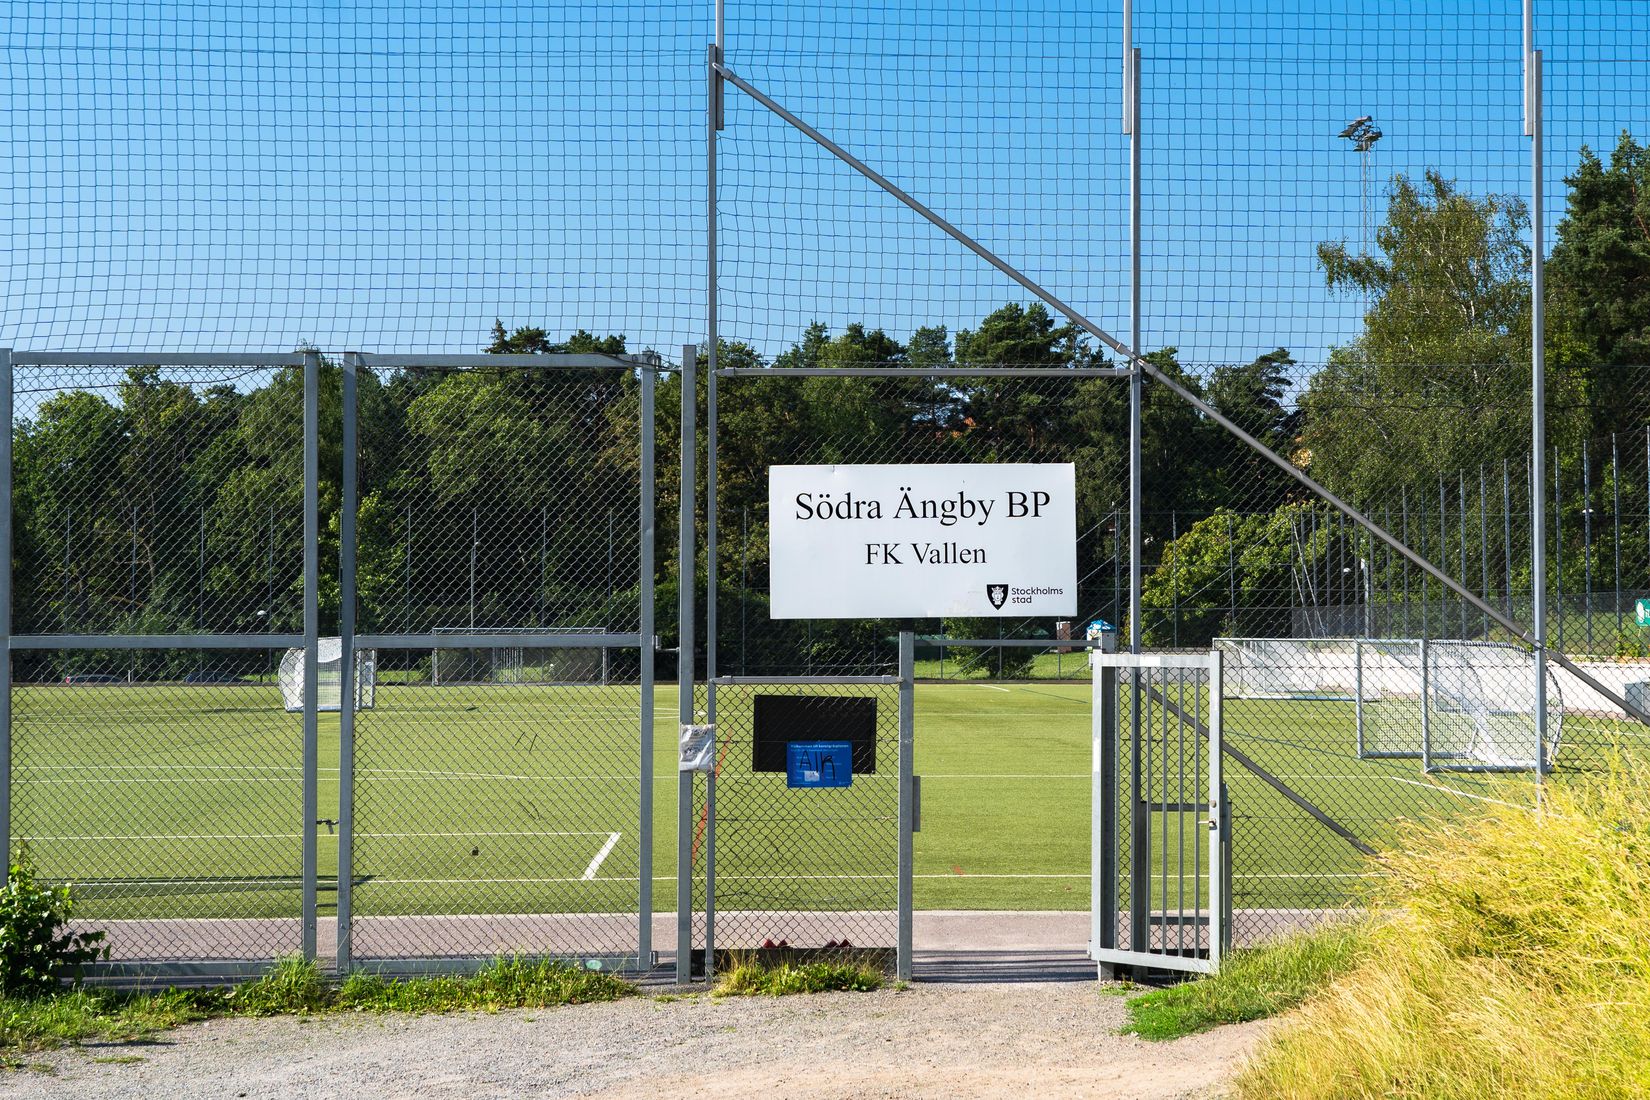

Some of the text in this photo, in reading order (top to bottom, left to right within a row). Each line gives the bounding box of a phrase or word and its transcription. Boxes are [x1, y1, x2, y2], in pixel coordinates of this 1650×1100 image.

[795, 486, 1051, 527] Södra Ängby BP
[865, 542, 987, 565] FK Vallen
[1011, 586, 1064, 596] Stockholms
[1011, 596, 1032, 604] stad
